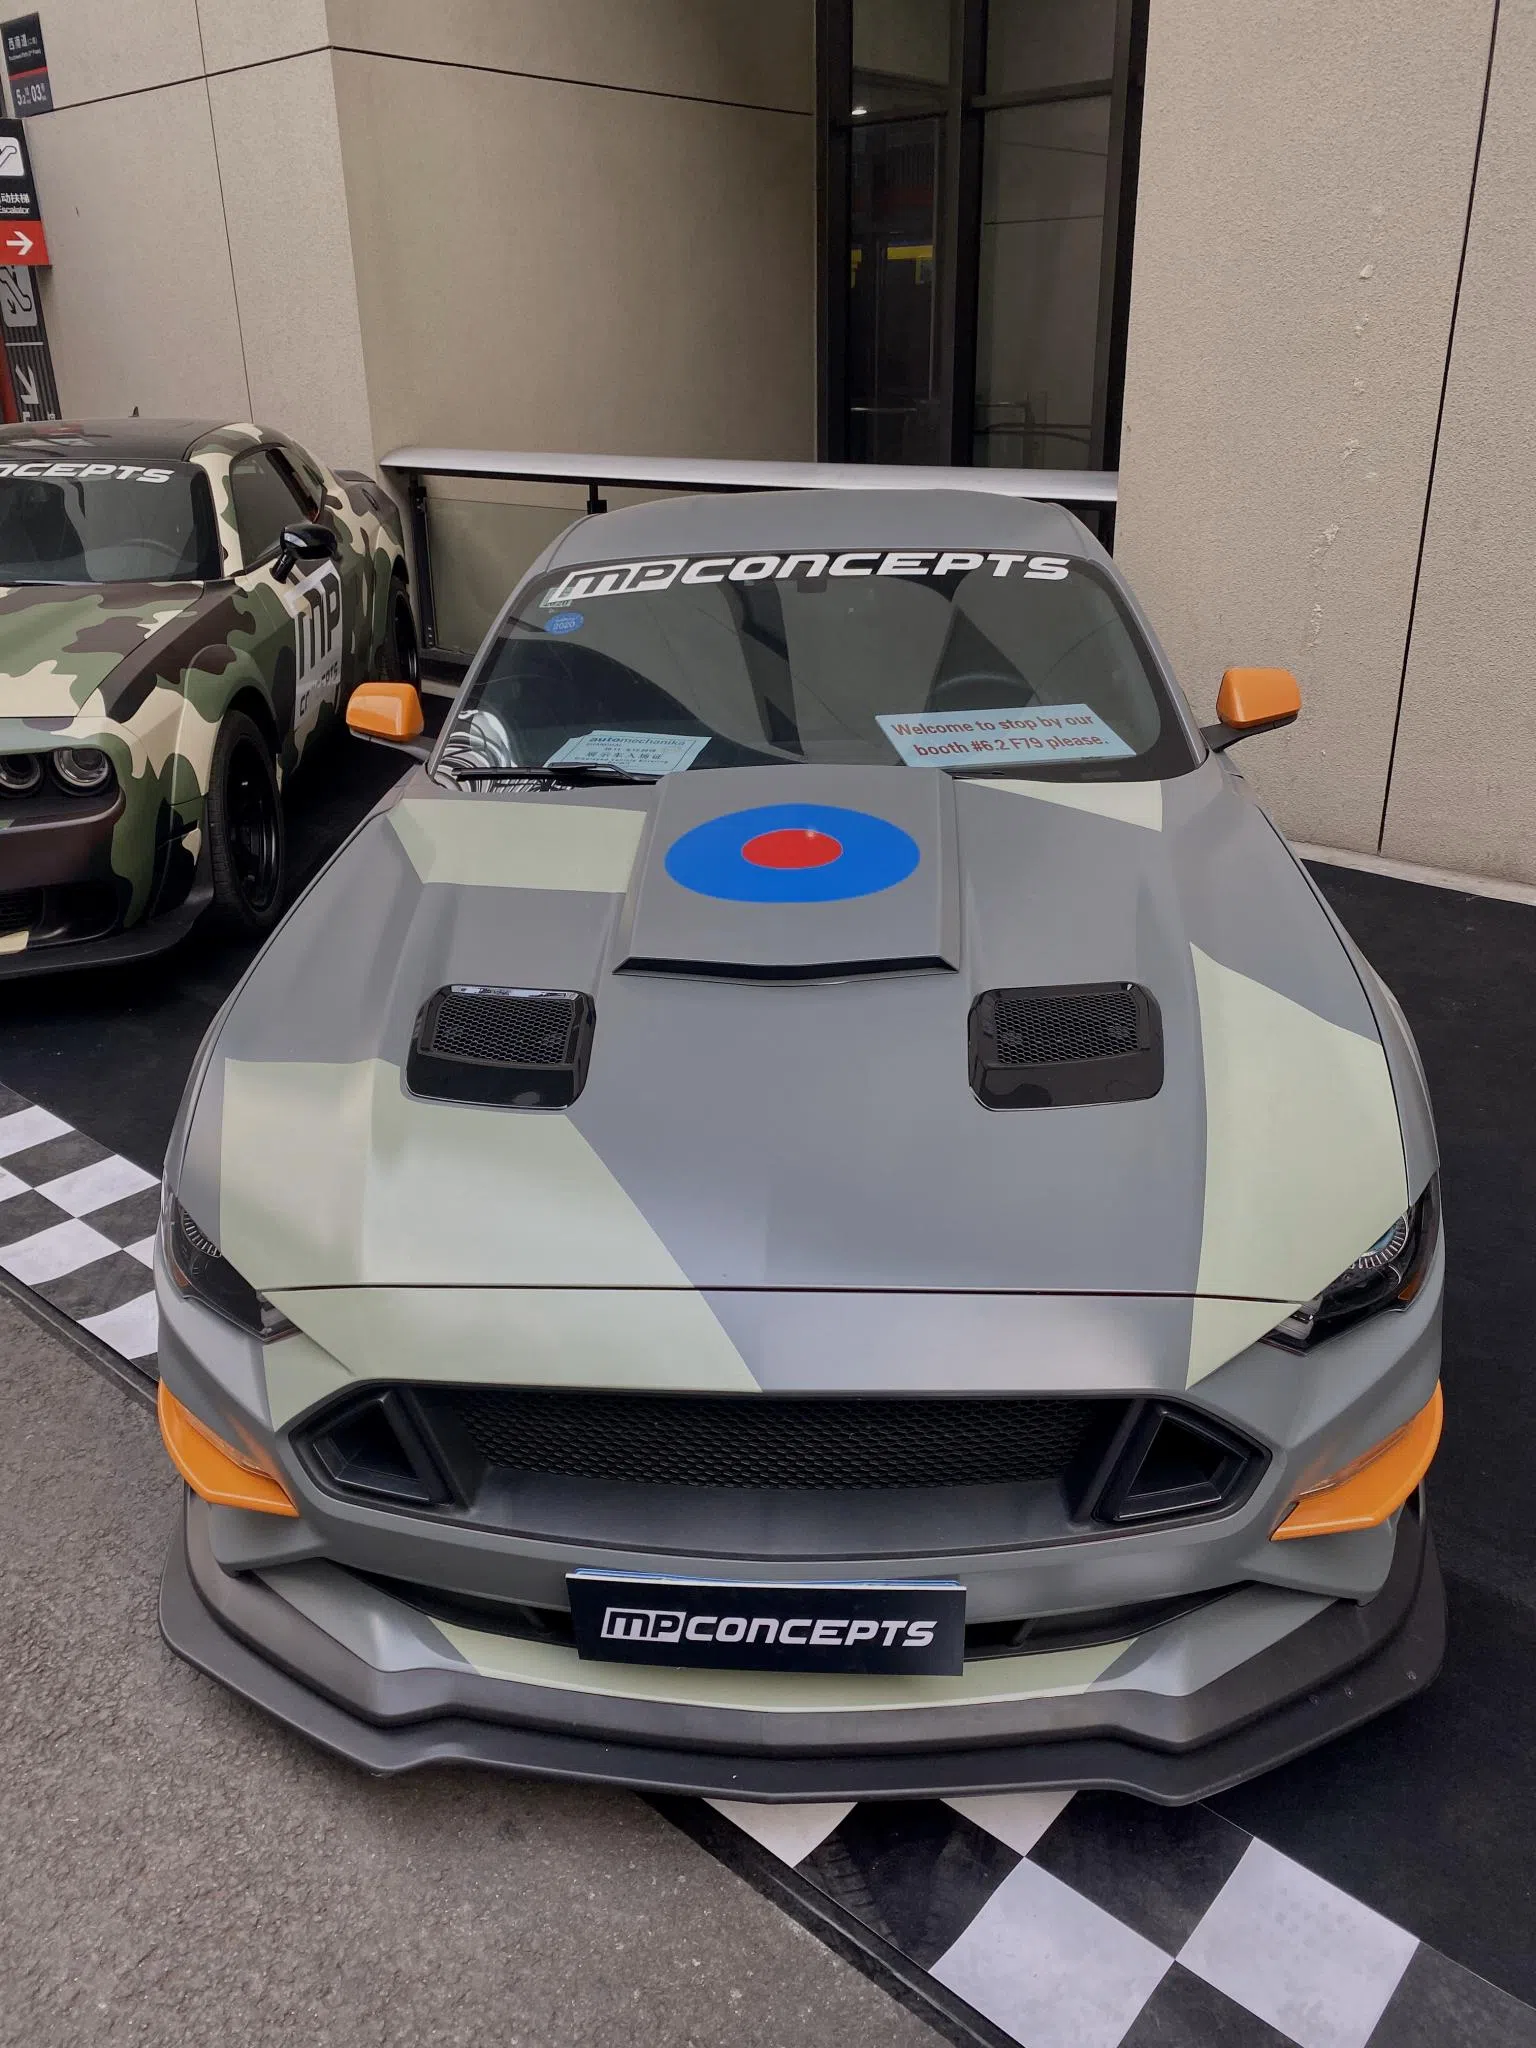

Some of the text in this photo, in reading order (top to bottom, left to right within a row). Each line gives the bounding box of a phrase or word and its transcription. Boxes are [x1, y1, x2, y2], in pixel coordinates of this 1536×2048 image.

[891, 714, 1095, 736] Welcome to stop by our
[588, 737, 686, 746] automechanika
[913, 734, 1109, 756] booth #6.2 F79 please.
